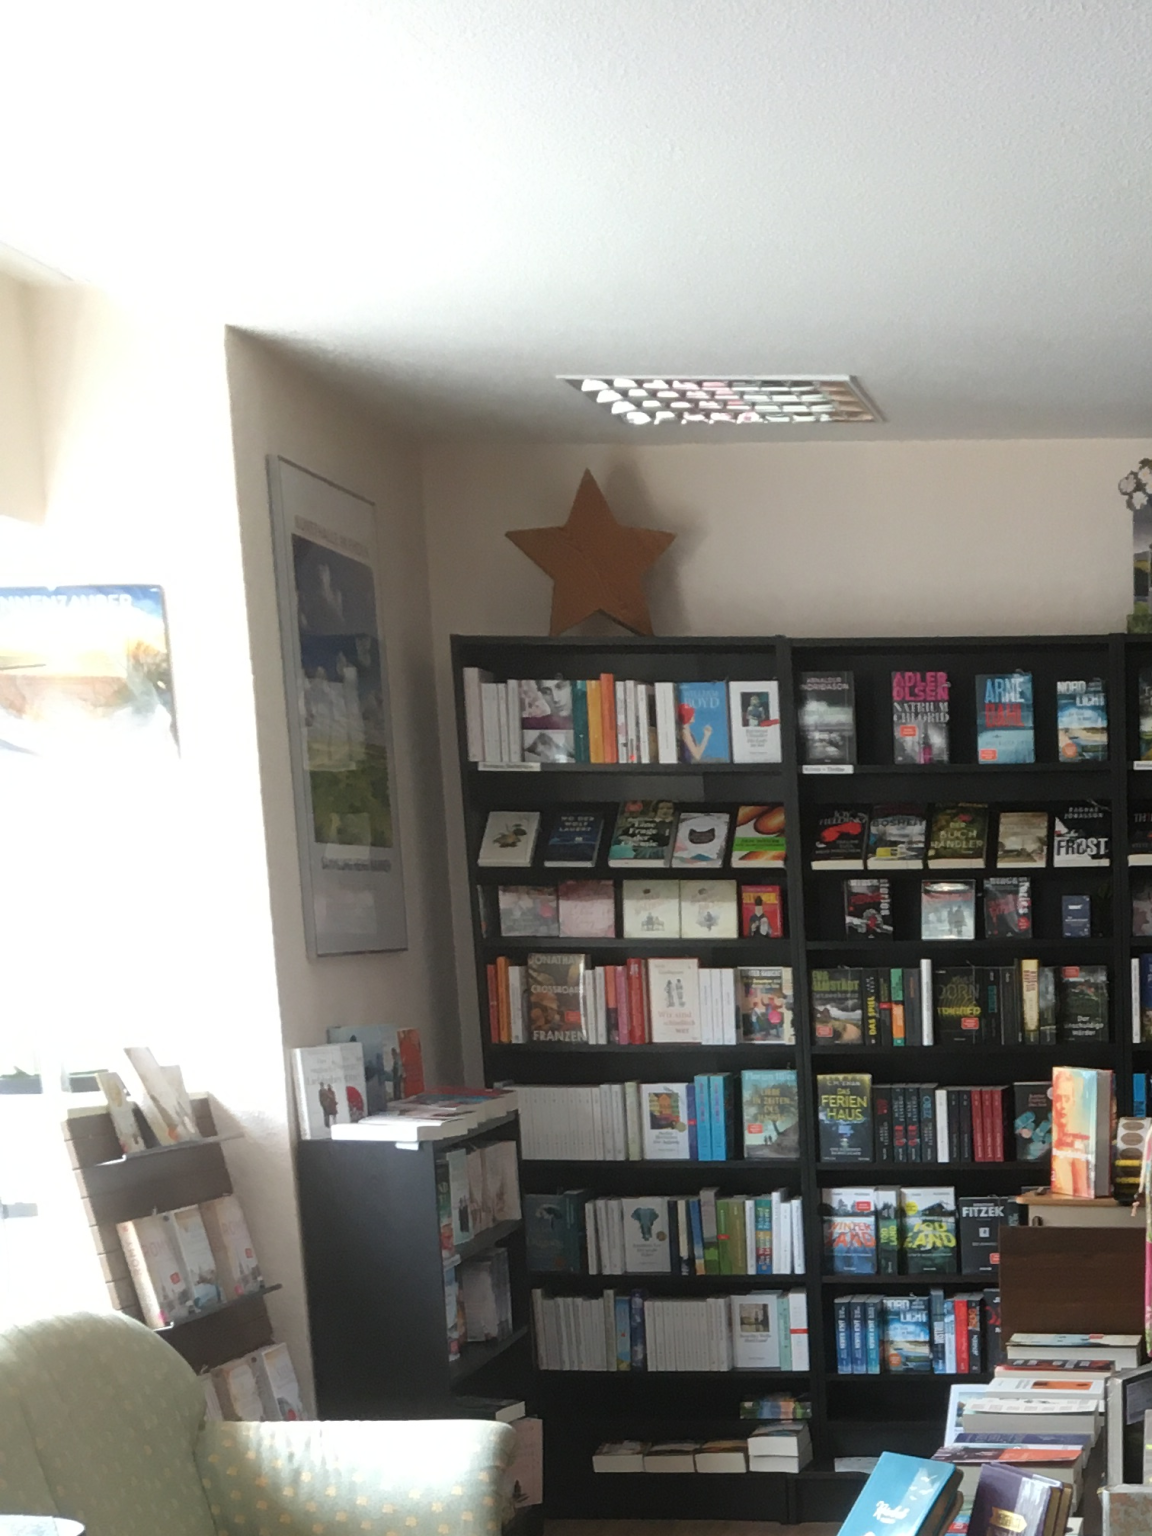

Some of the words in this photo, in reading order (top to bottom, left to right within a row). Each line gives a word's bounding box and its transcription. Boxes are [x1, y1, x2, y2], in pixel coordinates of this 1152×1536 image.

[893, 671, 948, 687] ADLER
[985, 678, 1024, 703] ARNE
[1057, 681, 1086, 694] NORD
[893, 687, 950, 701] OLSEN
[1076, 694, 1105, 706] LICHT
[684, 698, 720, 709] BOYD
[893, 701, 949, 712] NATRIUM
[893, 712, 950, 723] CHLORID
[985, 703, 1024, 728] DAHL
[940, 831, 977, 839] BUCH
[1056, 838, 1109, 856] FROST
[867, 996, 875, 1016] SPIEL
[533, 1031, 587, 1042] FRANZEN
[821, 1095, 868, 1108] FERIEN
[923, 1096, 932, 1118] ZERO
[827, 1108, 864, 1120] HAUS
[962, 1206, 1004, 1218] FITZEK
[831, 1222, 871, 1233] WINTER
[914, 1222, 948, 1233] TOD
[825, 1231, 877, 1248] LAND
[903, 1231, 957, 1248] LAND
[883, 1299, 910, 1311] NORD
[900, 1310, 928, 1322] LICHT
